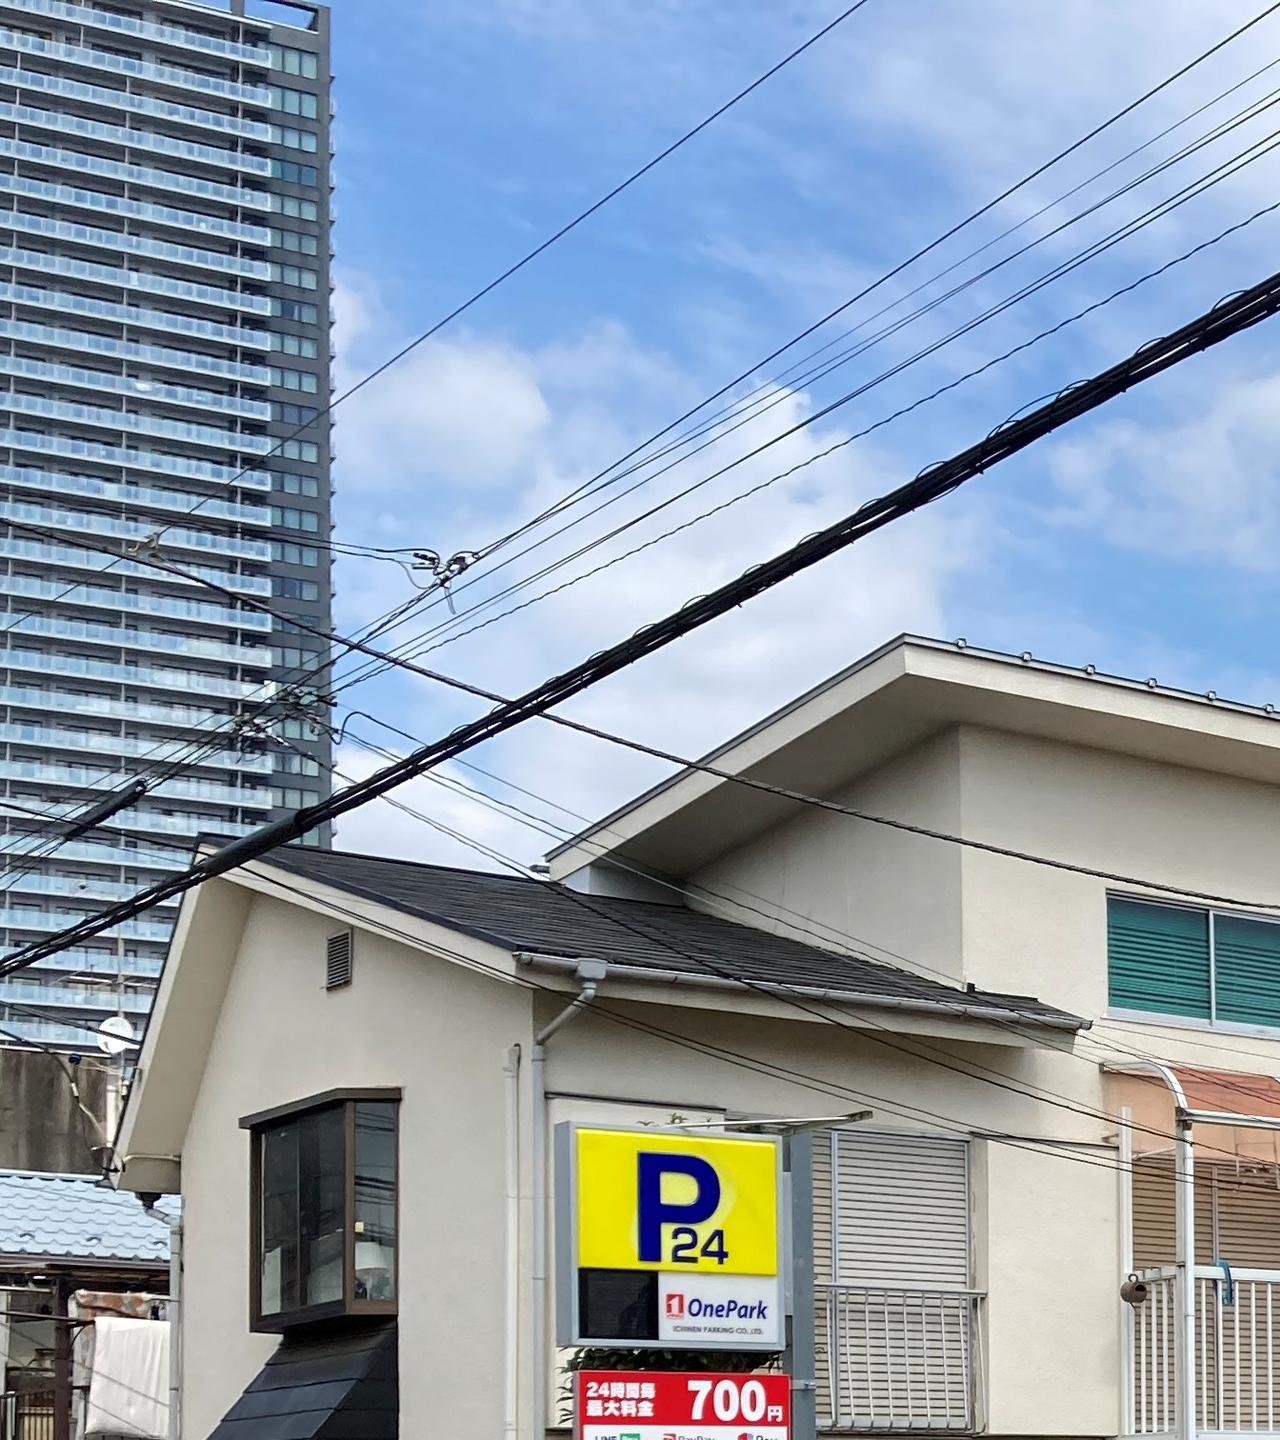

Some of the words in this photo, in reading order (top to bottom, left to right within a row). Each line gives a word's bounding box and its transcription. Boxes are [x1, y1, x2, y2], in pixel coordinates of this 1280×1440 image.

[637, 1151, 721, 1262] P
[671, 1226, 730, 1265] 24
[688, 1298, 768, 1320] OnePark
[703, 1326, 734, 1335] PARKING
[586, 1400, 655, 1418] 最大料金
[687, 1379, 784, 1422] 700円
